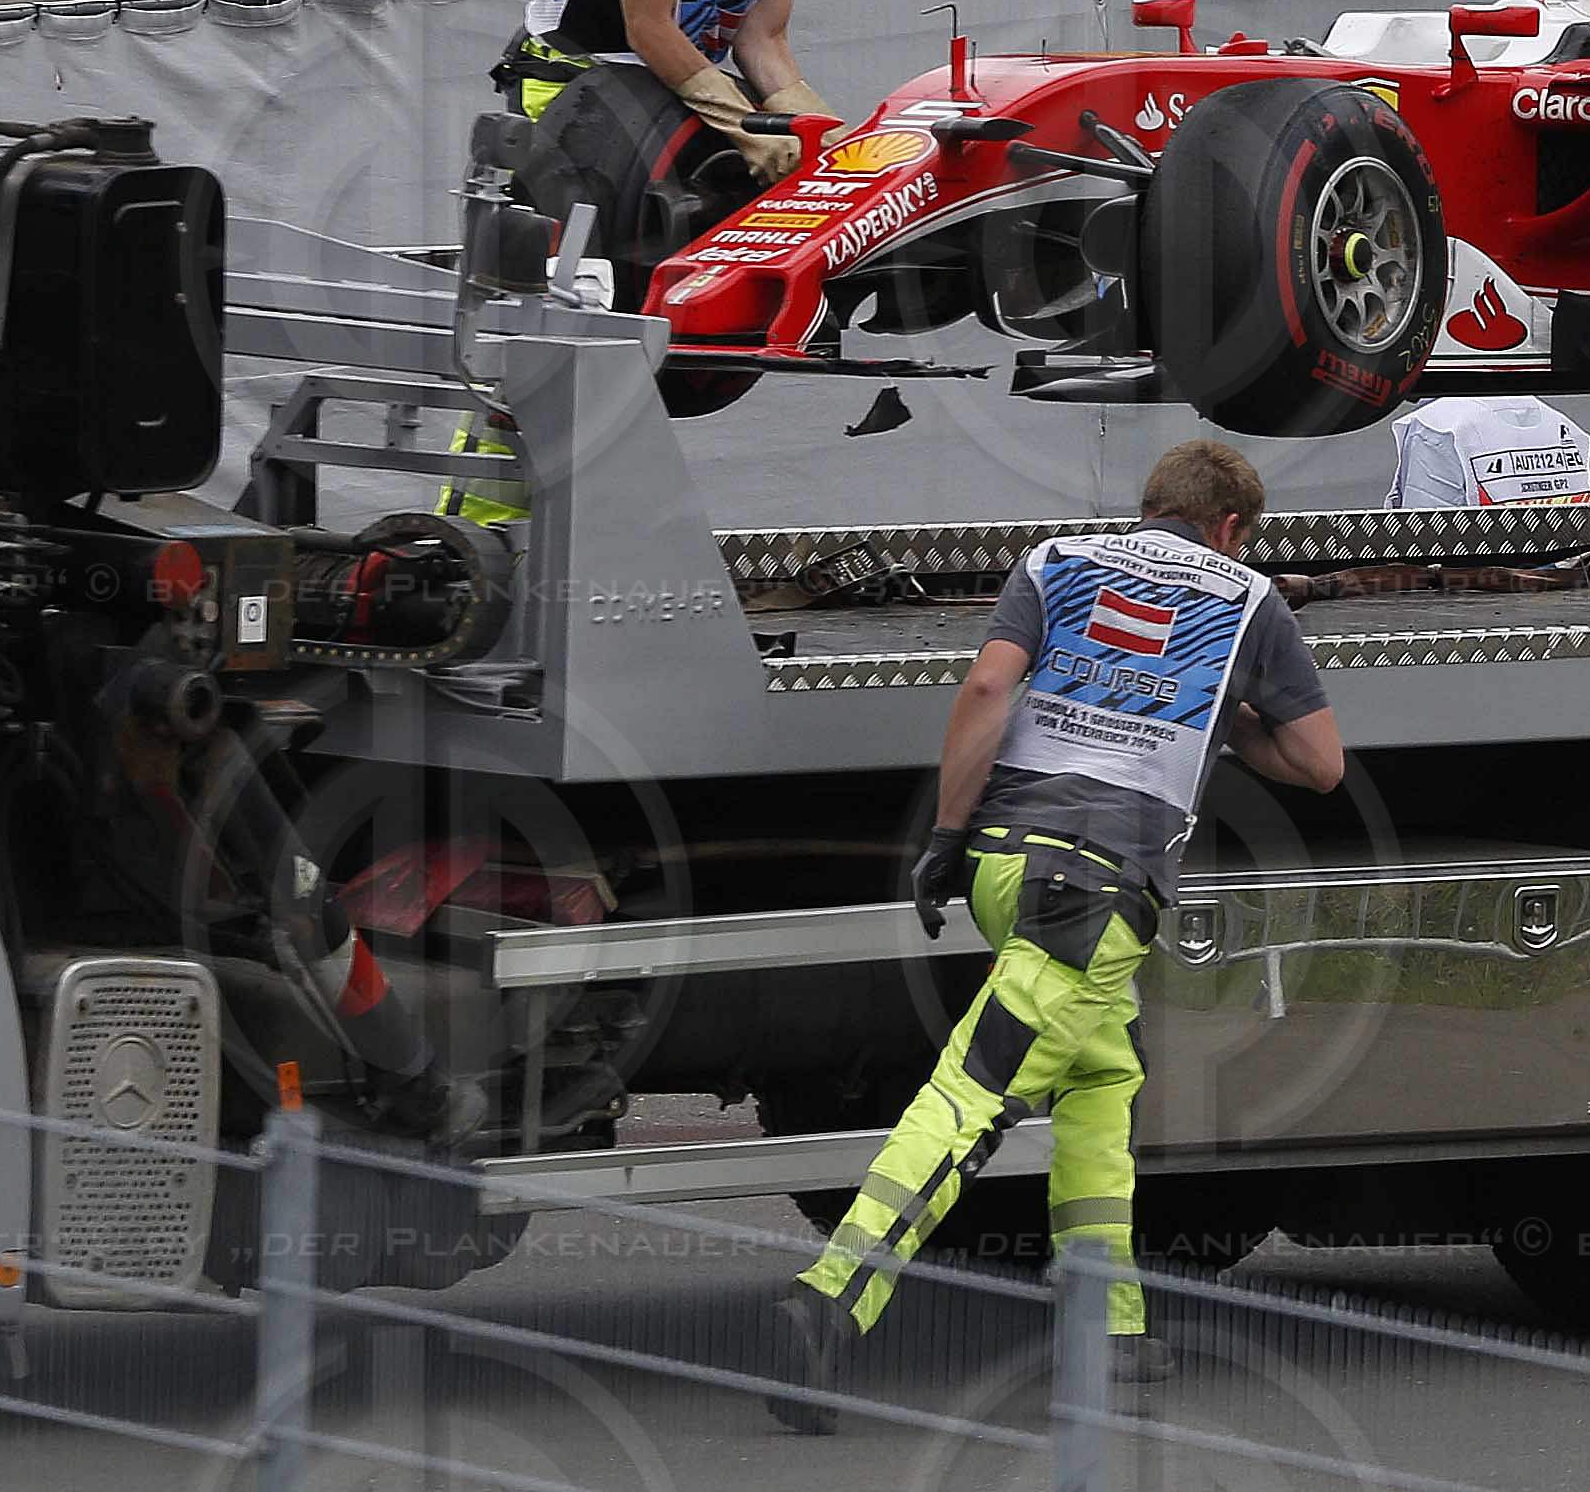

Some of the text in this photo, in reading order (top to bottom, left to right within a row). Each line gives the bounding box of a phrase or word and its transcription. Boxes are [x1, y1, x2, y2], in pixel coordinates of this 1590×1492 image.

[796, 180, 874, 195] TNT
[710, 230, 812, 245] MAHLE
[822, 176, 924, 271] KASPERSKY
[1049, 648, 1180, 701] COURSE
